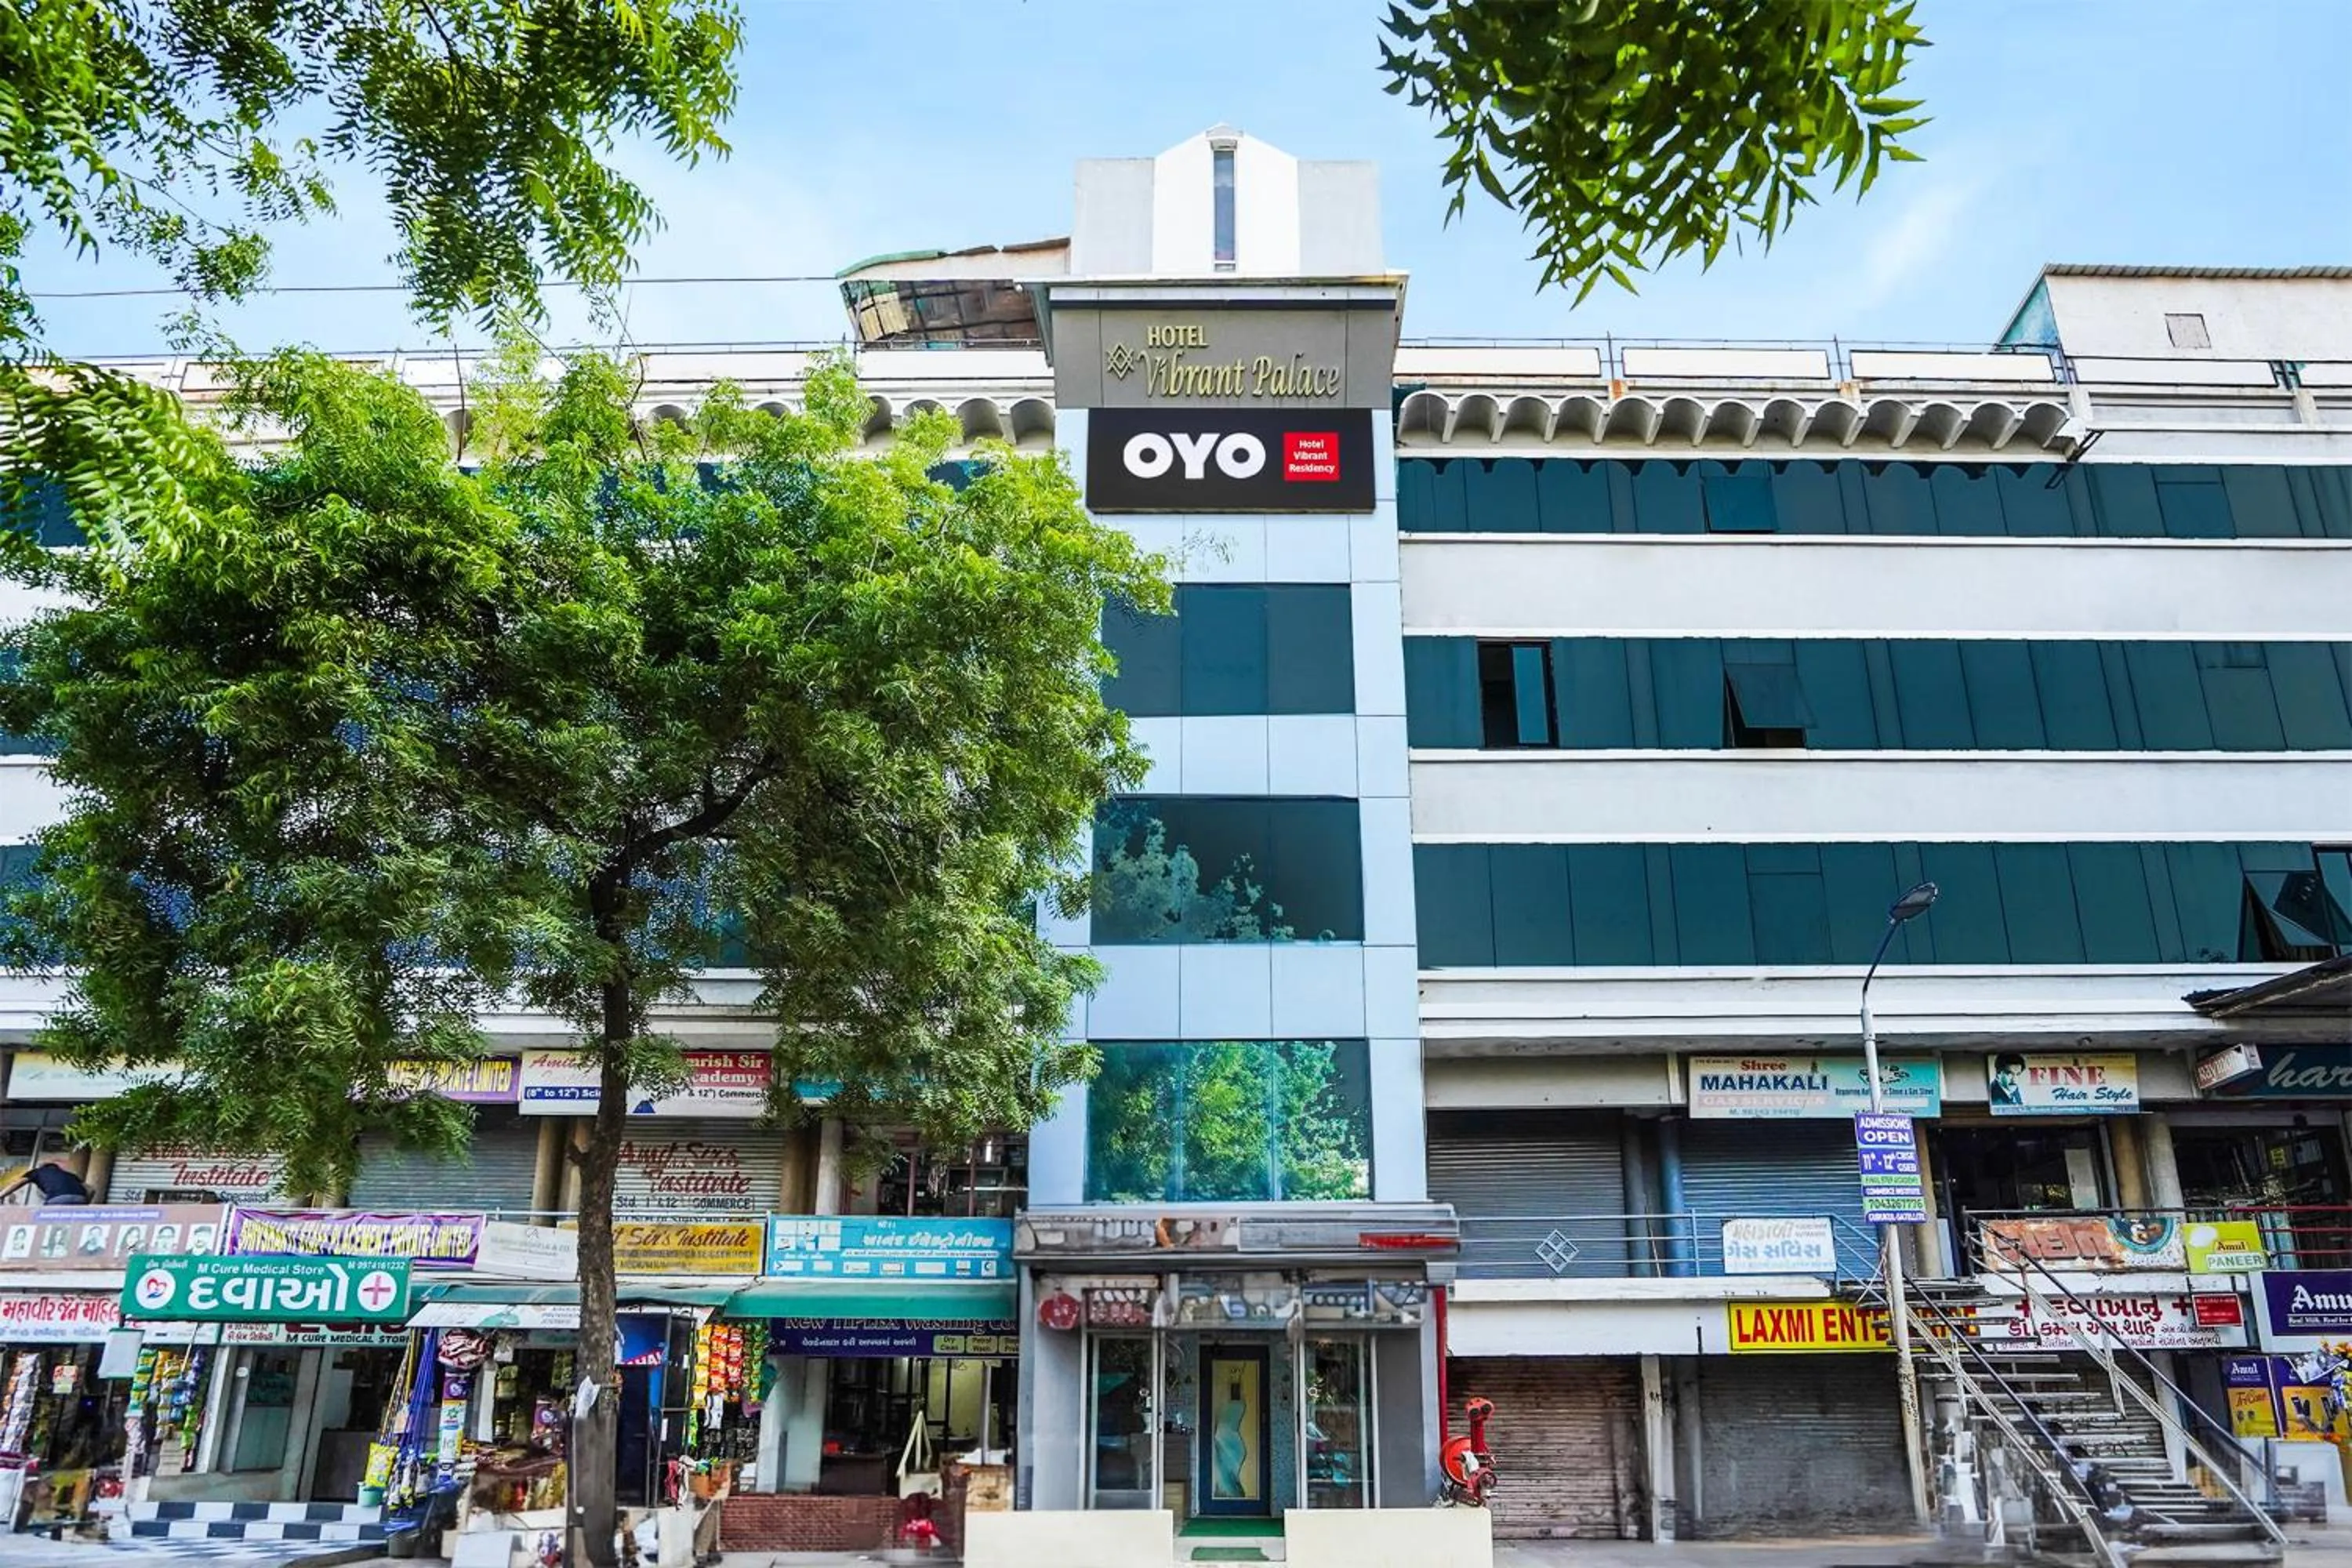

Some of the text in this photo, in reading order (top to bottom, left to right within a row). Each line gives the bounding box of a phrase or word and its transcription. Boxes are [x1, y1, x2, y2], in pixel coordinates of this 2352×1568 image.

[1147, 325, 1209, 347] HOTEL
[1137, 350, 1340, 397] Vibrant Palace
[1299, 439, 1324, 449] Hotel
[1123, 432, 1266, 480] OYO
[1293, 451, 1328, 461] Vibrant
[1288, 463, 1336, 474] Residency
[684, 1054, 764, 1069] mrish Sir
[1740, 1059, 1788, 1072] Shree
[690, 1070, 757, 1084] cademy
[1700, 1074, 1828, 1091] MAHAKALI
[2028, 1065, 2106, 1086] FINE
[2052, 1086, 2133, 1102] Hair Style
[1859, 1117, 1911, 1130] ADMISSIONS
[1863, 1131, 1911, 1143] OPEN
[169, 1160, 270, 1187] Institute
[691, 1196, 752, 1210] COMMERCE
[627, 1227, 672, 1247] Sir's
[676, 1227, 751, 1248] Institute
[2216, 1241, 2246, 1250] Amul
[2208, 1255, 2263, 1268] PANEER
[198, 1264, 325, 1276] M Cure Medical Store
[187, 1263, 350, 1312] દવાઓ
[2, 1297, 56, 1323] મહાવીર
[1736, 1308, 1815, 1343] LAXMI
[285, 1334, 299, 1343] M
[301, 1334, 327, 1343] CURE
[329, 1334, 374, 1344] MEDICAL
[2231, 1363, 2258, 1374] Amul
